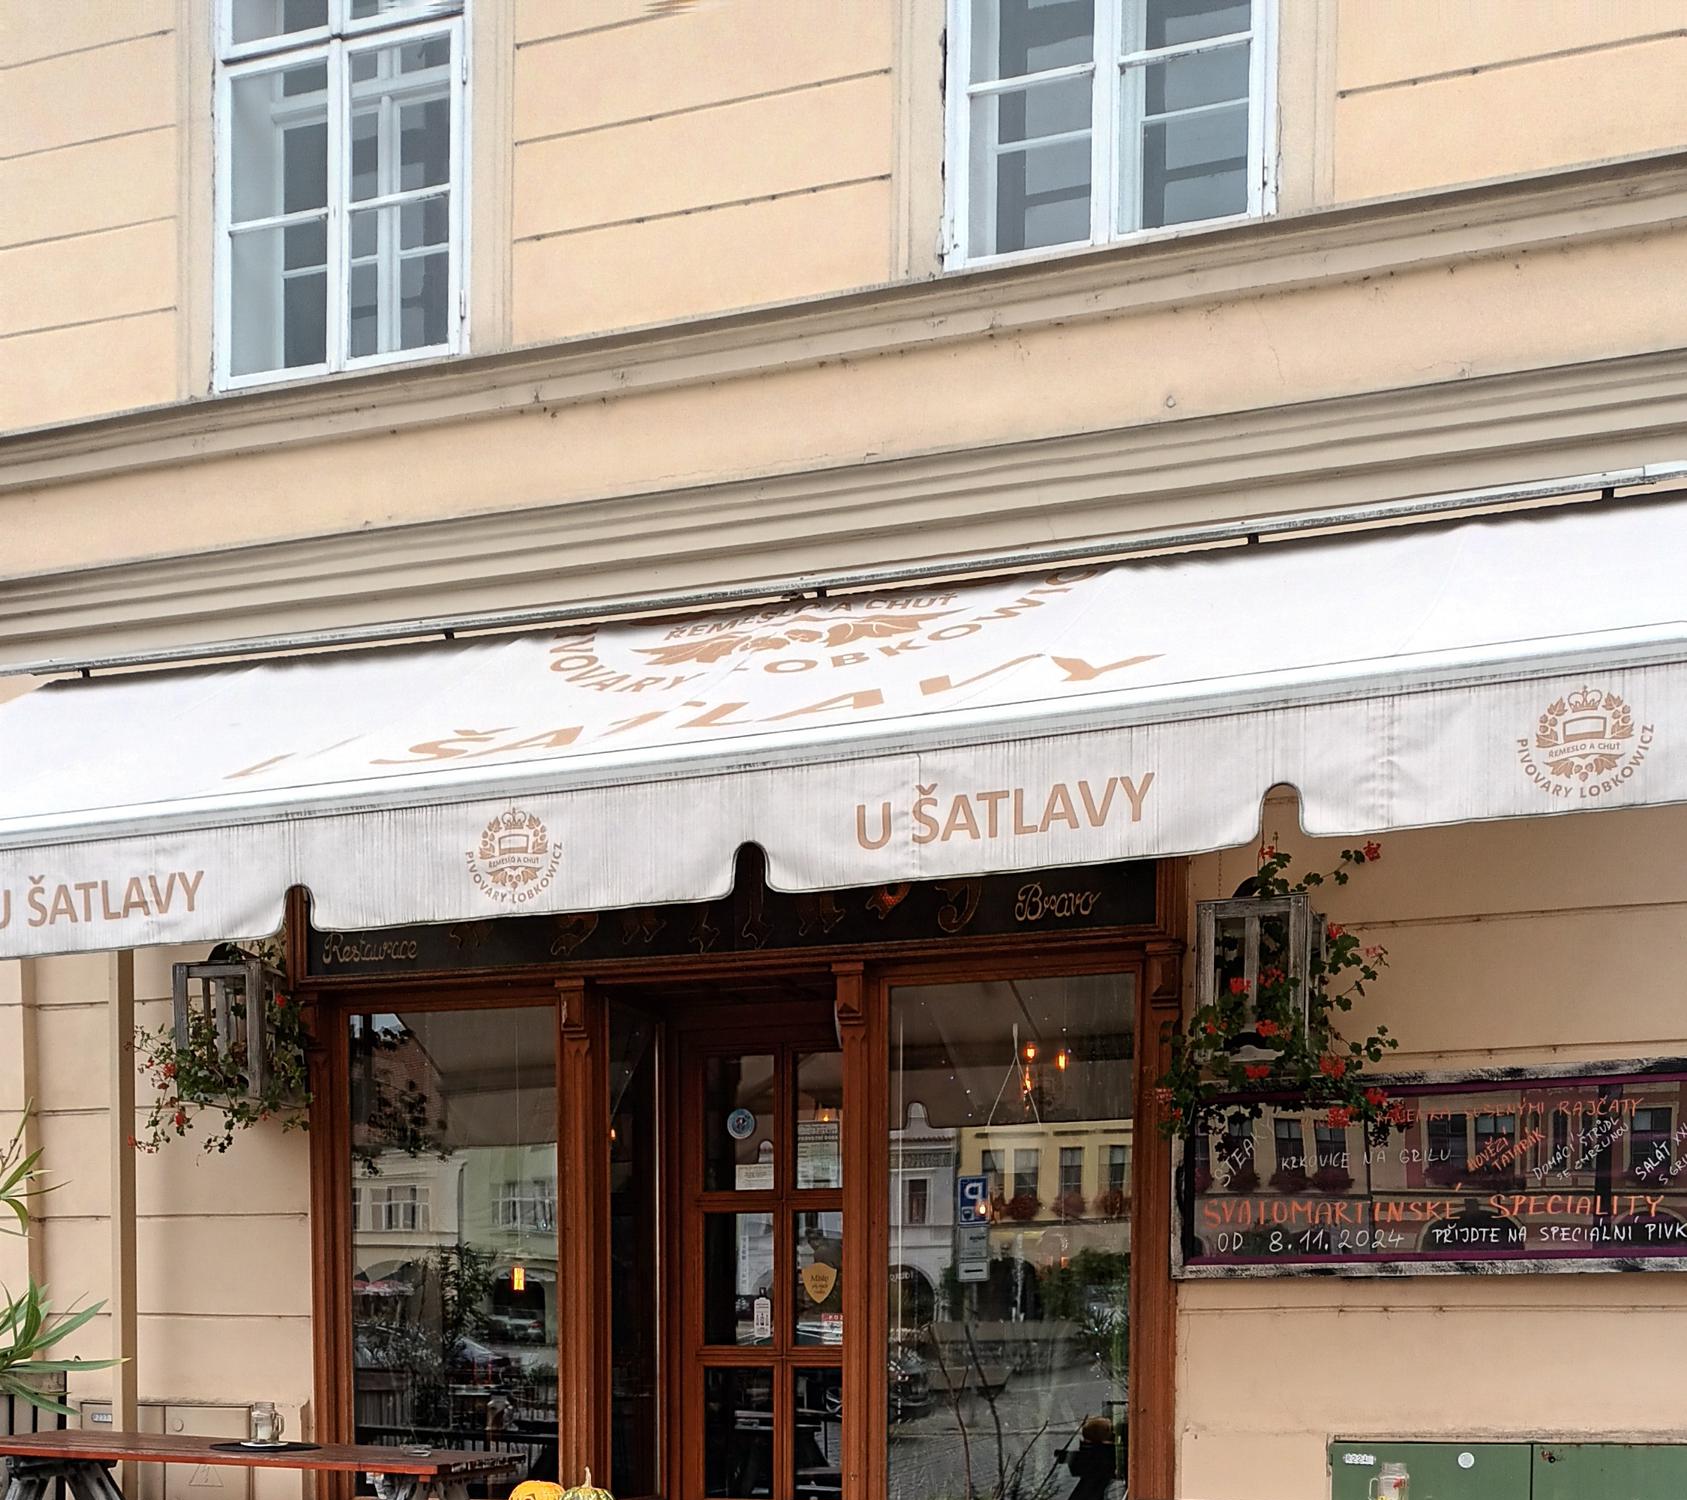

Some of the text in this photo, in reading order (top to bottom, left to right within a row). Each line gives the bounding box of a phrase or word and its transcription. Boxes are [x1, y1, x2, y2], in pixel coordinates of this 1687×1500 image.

[549, 626, 708, 693] IVOVARY
[1516, 724, 1655, 799] PIVOVARY LOBKOWICZ
[1589, 742, 1596, 750] A
[856, 772, 1155, 850] U ŠATLAVY
[465, 842, 563, 904] PIVOVARY LOBKOWICZ
[27, 870, 205, 928] ŠATLAVY
[1559, 1094, 1645, 1118] RAJČATY
[1363, 1150, 1386, 1166] NA
[1399, 1149, 1451, 1165] GRILU
[1532, 1131, 1575, 1181] DOMÁCÍ
[1635, 1141, 1671, 1182] SALÁT
[1658, 1173, 1669, 1185] S
[1203, 1183, 1665, 1229] SVATOMARTINSKÉ SPECIALITY
[1217, 1231, 1243, 1253] OD
[1508, 1226, 1527, 1243] NA
[1540, 1215, 1639, 1243] SPECIÁLNÍ
